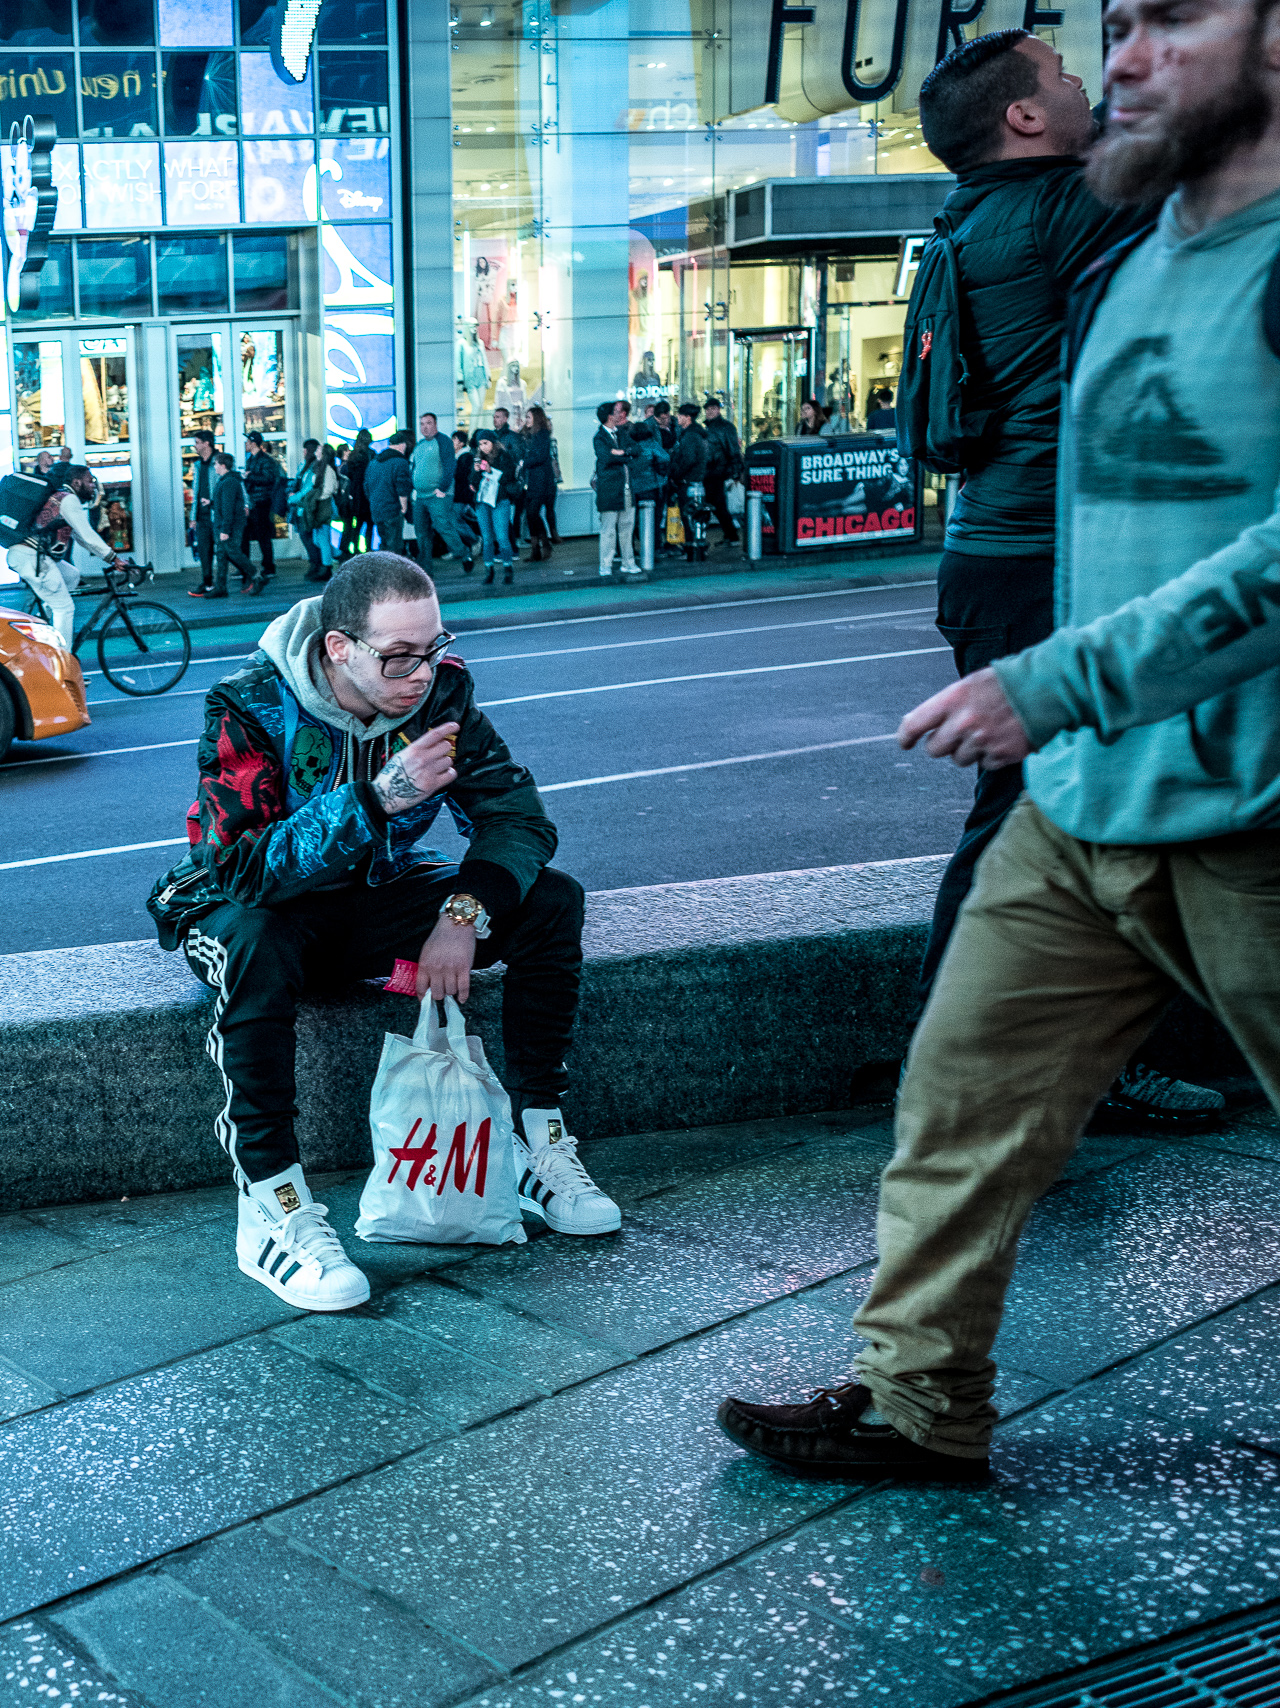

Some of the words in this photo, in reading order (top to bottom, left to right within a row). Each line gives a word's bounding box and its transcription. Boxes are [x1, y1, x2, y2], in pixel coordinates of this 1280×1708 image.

[163, 156, 244, 179] WHAT
[801, 448, 900, 470] BROADWAY'S
[800, 468, 843, 485] SURE
[846, 463, 892, 480] THING
[797, 507, 915, 540] CHICAGO
[388, 1117, 491, 1198] H&M
